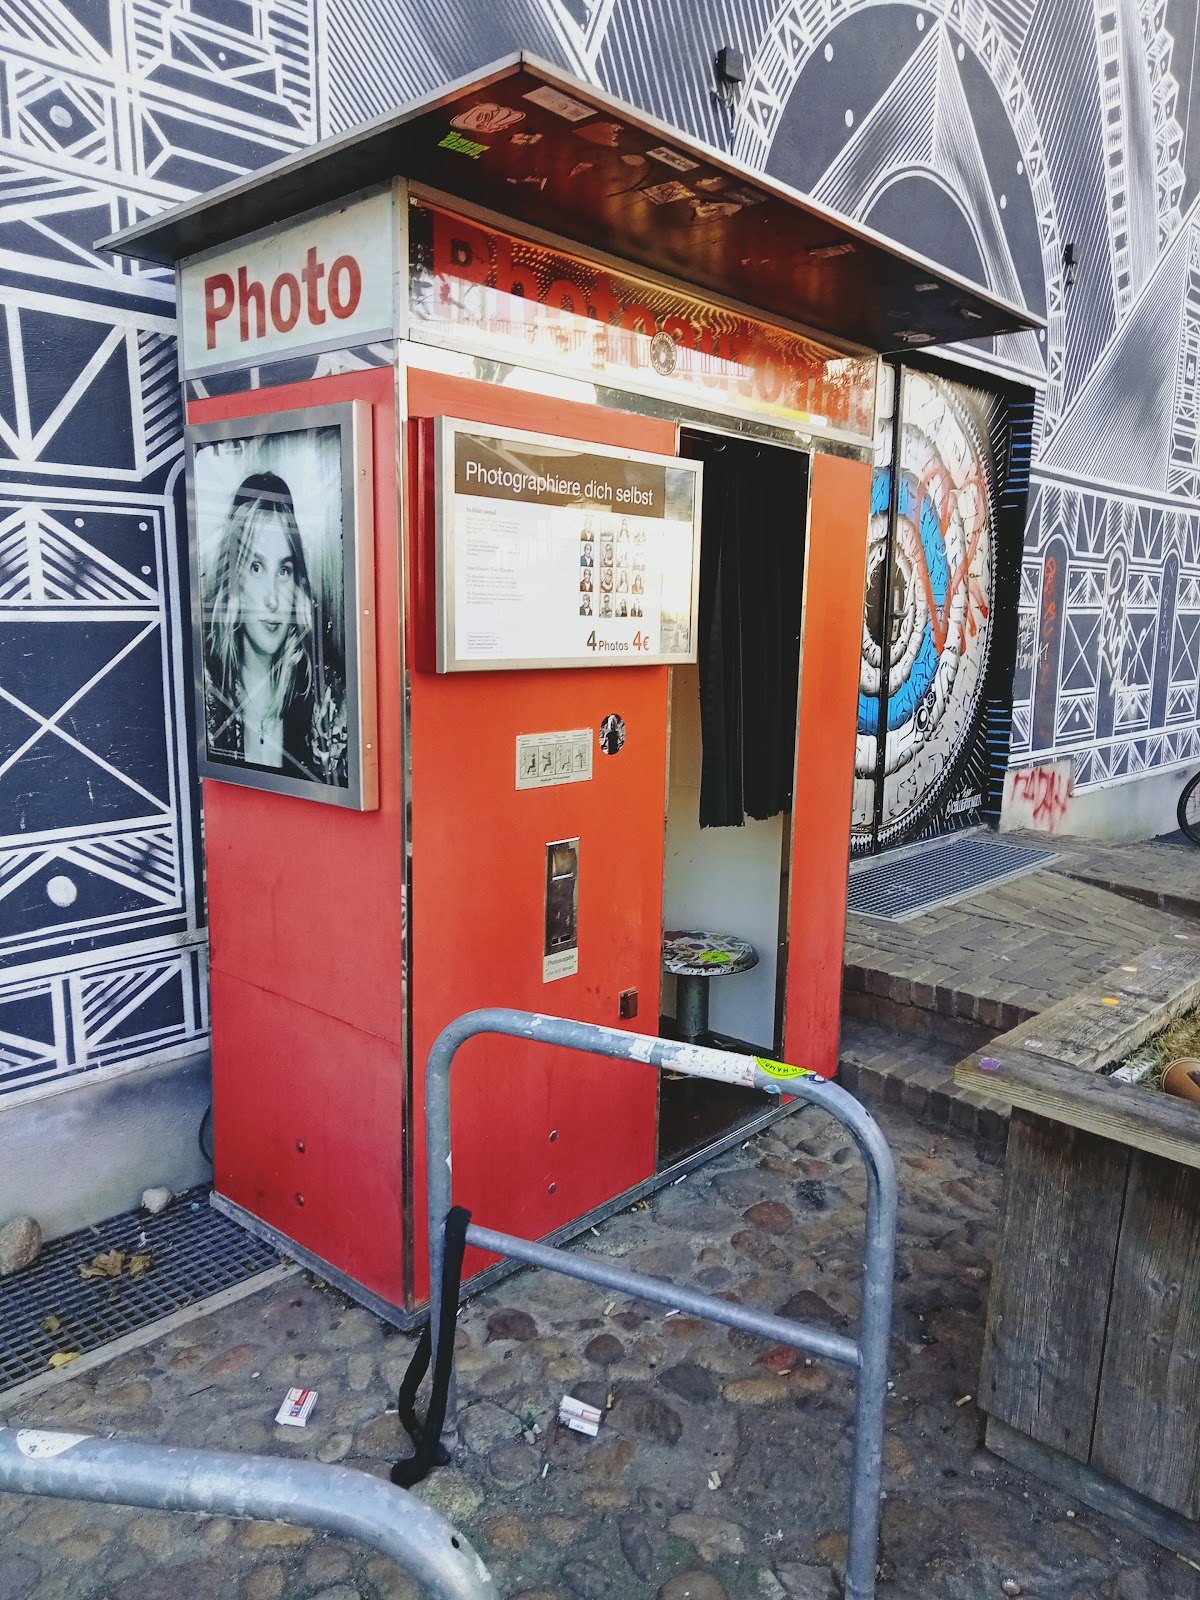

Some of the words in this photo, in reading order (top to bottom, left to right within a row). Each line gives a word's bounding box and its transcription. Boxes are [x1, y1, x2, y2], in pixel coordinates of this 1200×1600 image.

[204, 246, 362, 350] Photo
[465, 461, 581, 495] Photographiere
[584, 480, 613, 500] dich
[615, 486, 654, 506] selbst
[586, 630, 597, 651] 4
[599, 640, 629, 651] Photos
[632, 630, 650, 651] 4€
